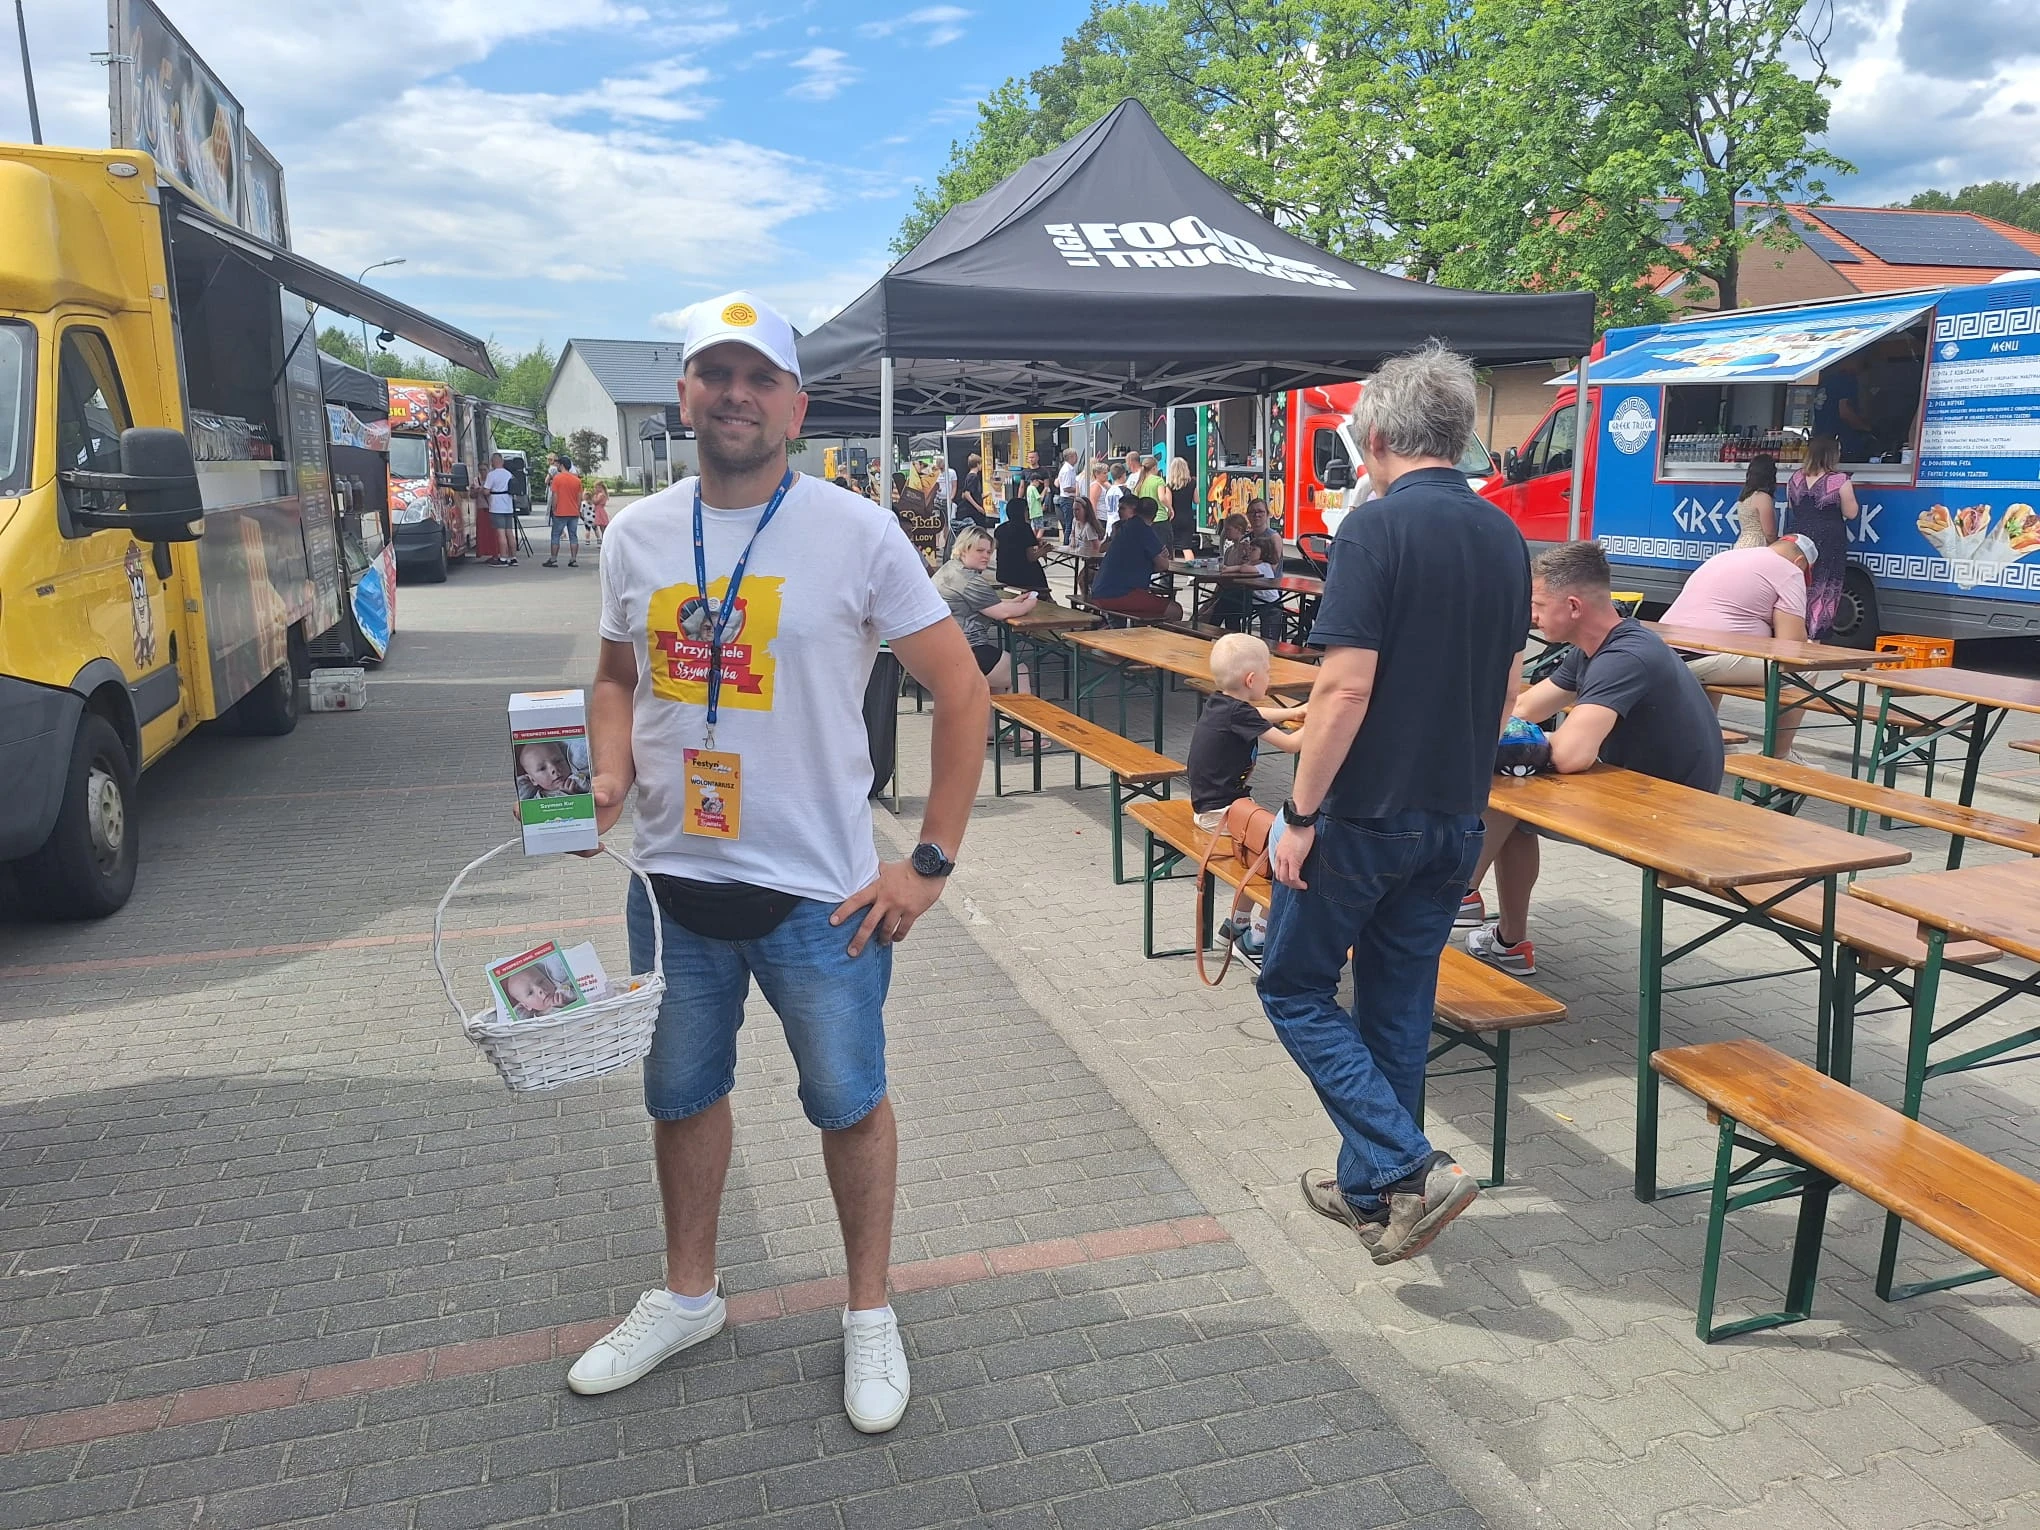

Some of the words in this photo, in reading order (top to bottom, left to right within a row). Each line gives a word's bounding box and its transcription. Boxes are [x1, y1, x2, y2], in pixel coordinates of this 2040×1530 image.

[1078, 215, 1271, 264] FOOD
[1990, 340, 2020, 353] MENU
[1611, 421, 1631, 430] GREEK
[1632, 420, 1653, 430] TRUCK
[1672, 497, 1741, 536] GREE
[915, 534, 934, 542] LODY
[674, 641, 744, 659] Przyjiele
[675, 661, 739, 680] Szymka
[692, 758, 719, 769] Festyn
